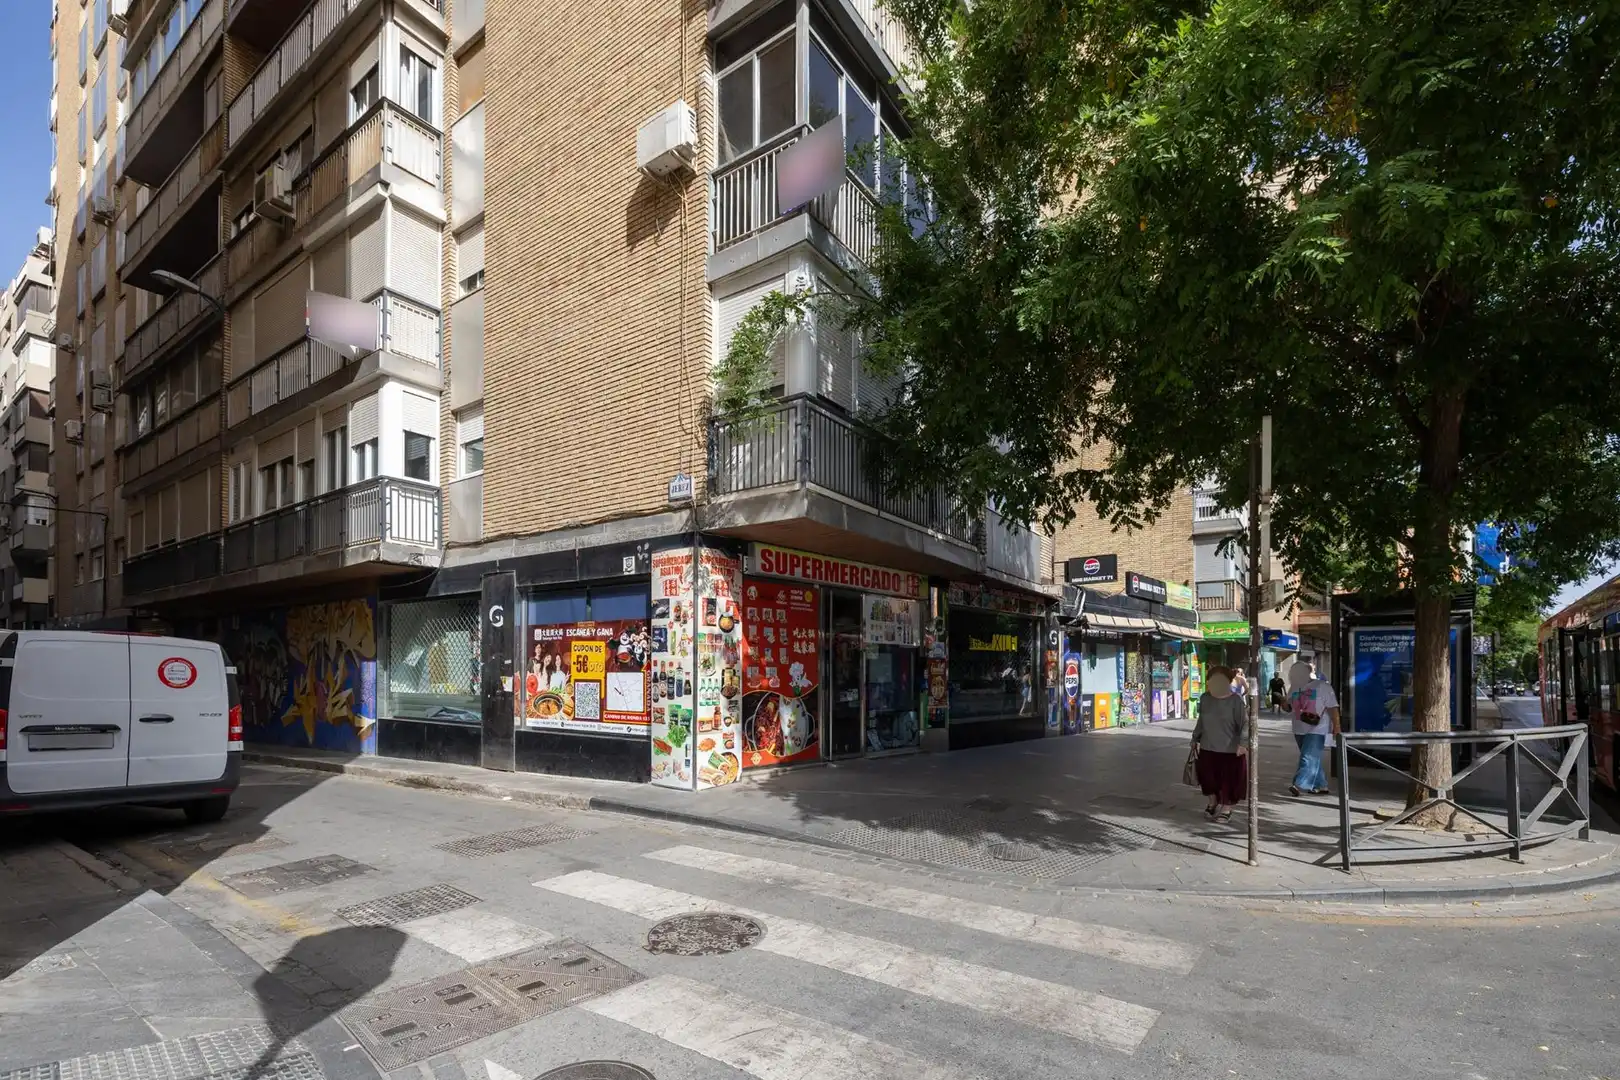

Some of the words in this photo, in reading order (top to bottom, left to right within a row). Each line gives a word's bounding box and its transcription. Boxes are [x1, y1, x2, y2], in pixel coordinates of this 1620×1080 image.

[760, 548, 900, 593] SUPERMERCADO
[566, 628, 590, 637] ESCANEA
[590, 628, 596, 636] Y
[597, 628, 613, 636] GANA
[595, 645, 602, 653] DE
